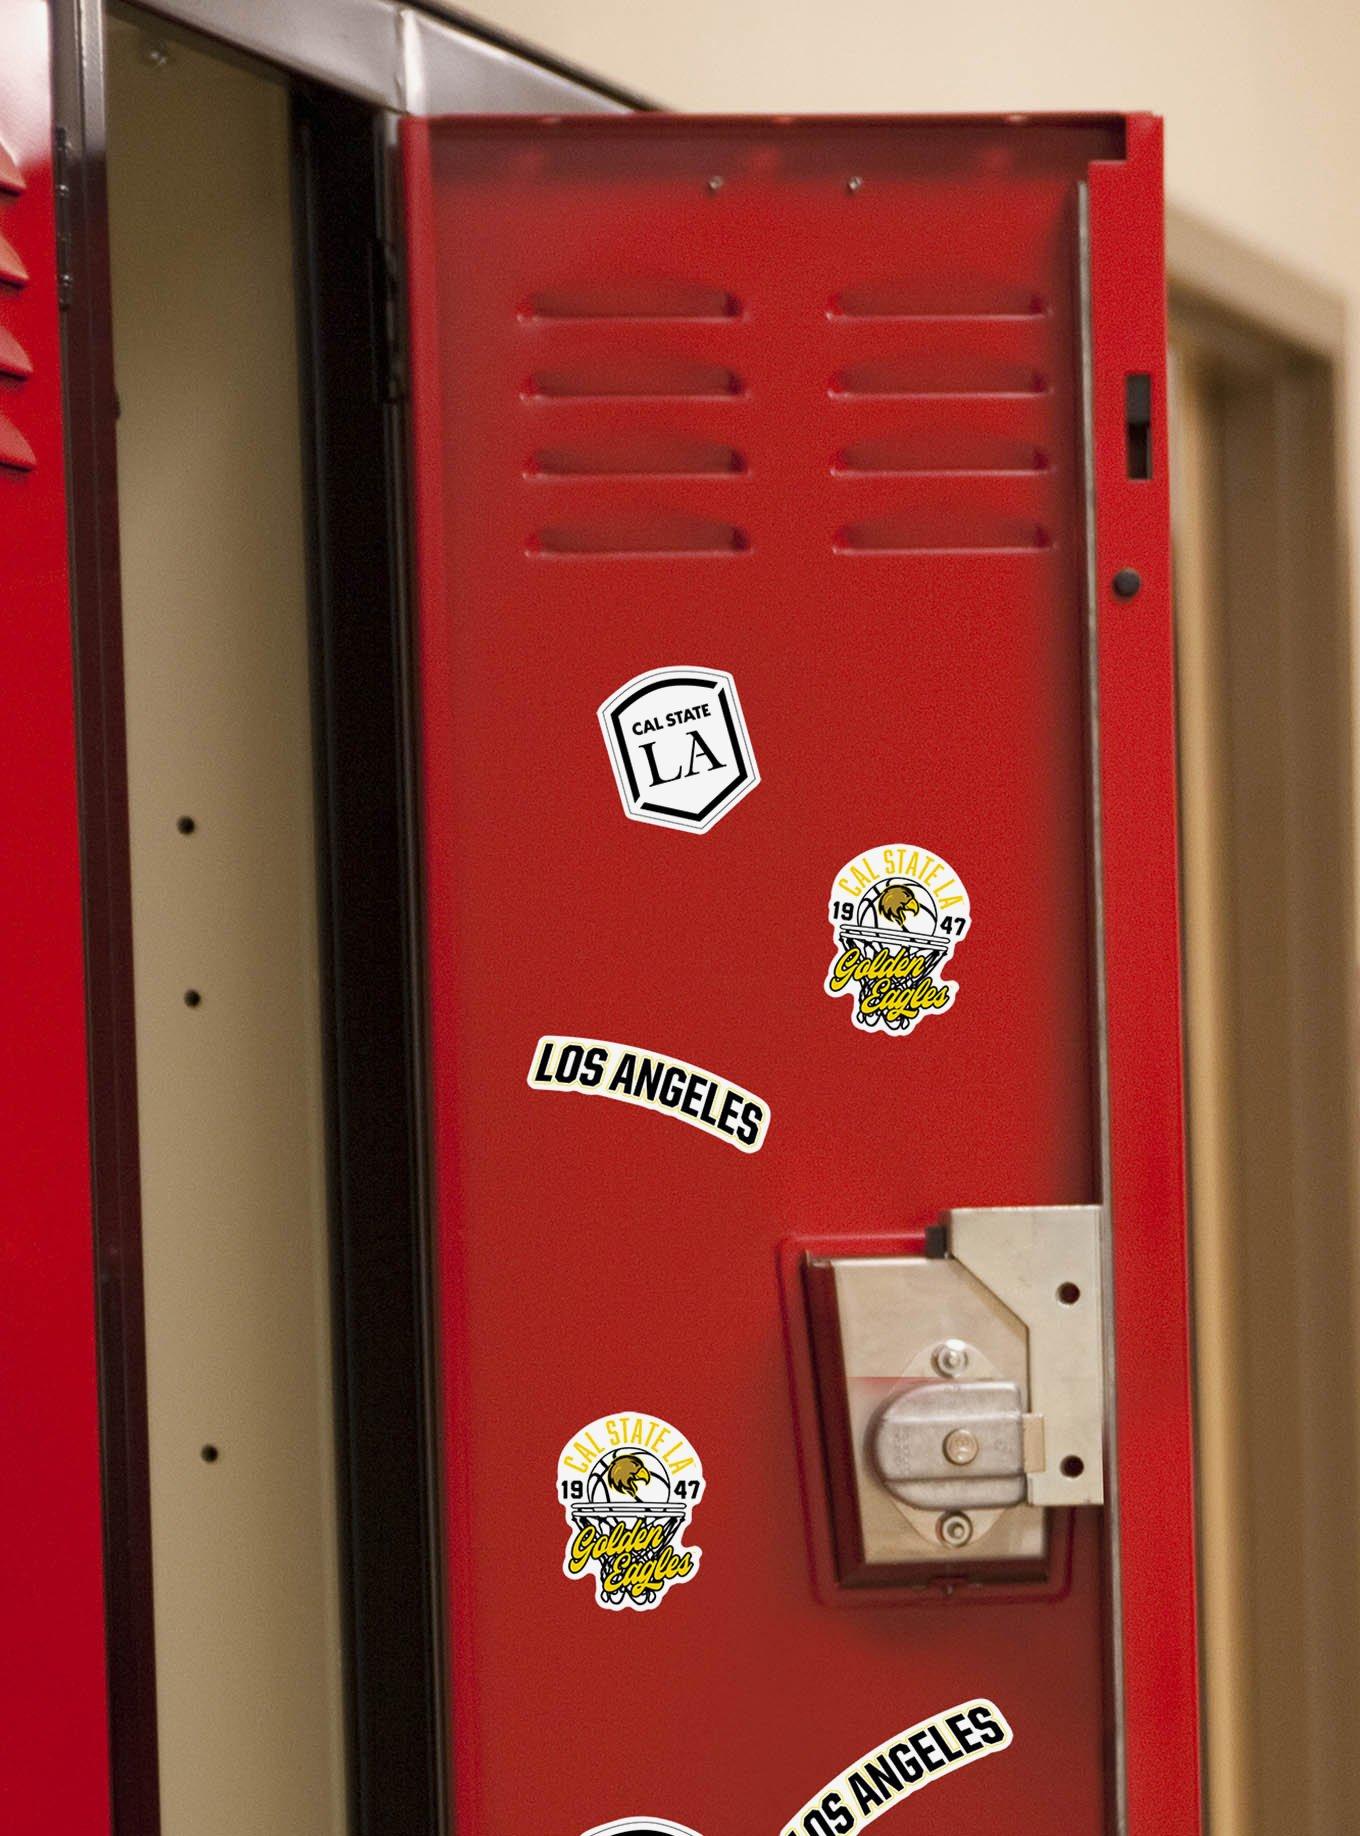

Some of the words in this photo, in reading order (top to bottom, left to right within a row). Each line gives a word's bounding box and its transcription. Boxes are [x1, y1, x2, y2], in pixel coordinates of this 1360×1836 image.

[632, 717, 664, 736] CAL
[666, 703, 711, 727] STATE
[638, 730, 727, 787] LA
[838, 858, 881, 898] CAL
[883, 849, 945, 887] STATE
[933, 878, 965, 910] LA
[832, 901, 854, 921] 19
[940, 916, 966, 936] 47
[829, 947, 926, 991] Golden
[859, 977, 950, 1022] Eagles
[535, 1043, 609, 1087] LOS
[608, 1053, 763, 1145] ANGELES
[563, 1431, 605, 1474] CAL
[605, 1417, 672, 1453] STATE
[662, 1441, 696, 1476] LA
[561, 1480, 583, 1499] 19
[674, 1480, 700, 1499] 47
[568, 1519, 664, 1573] Golden
[602, 1545, 694, 1597] Eagles
[788, 1792, 855, 1836] OS
[848, 1706, 1004, 1816] ANGELES
